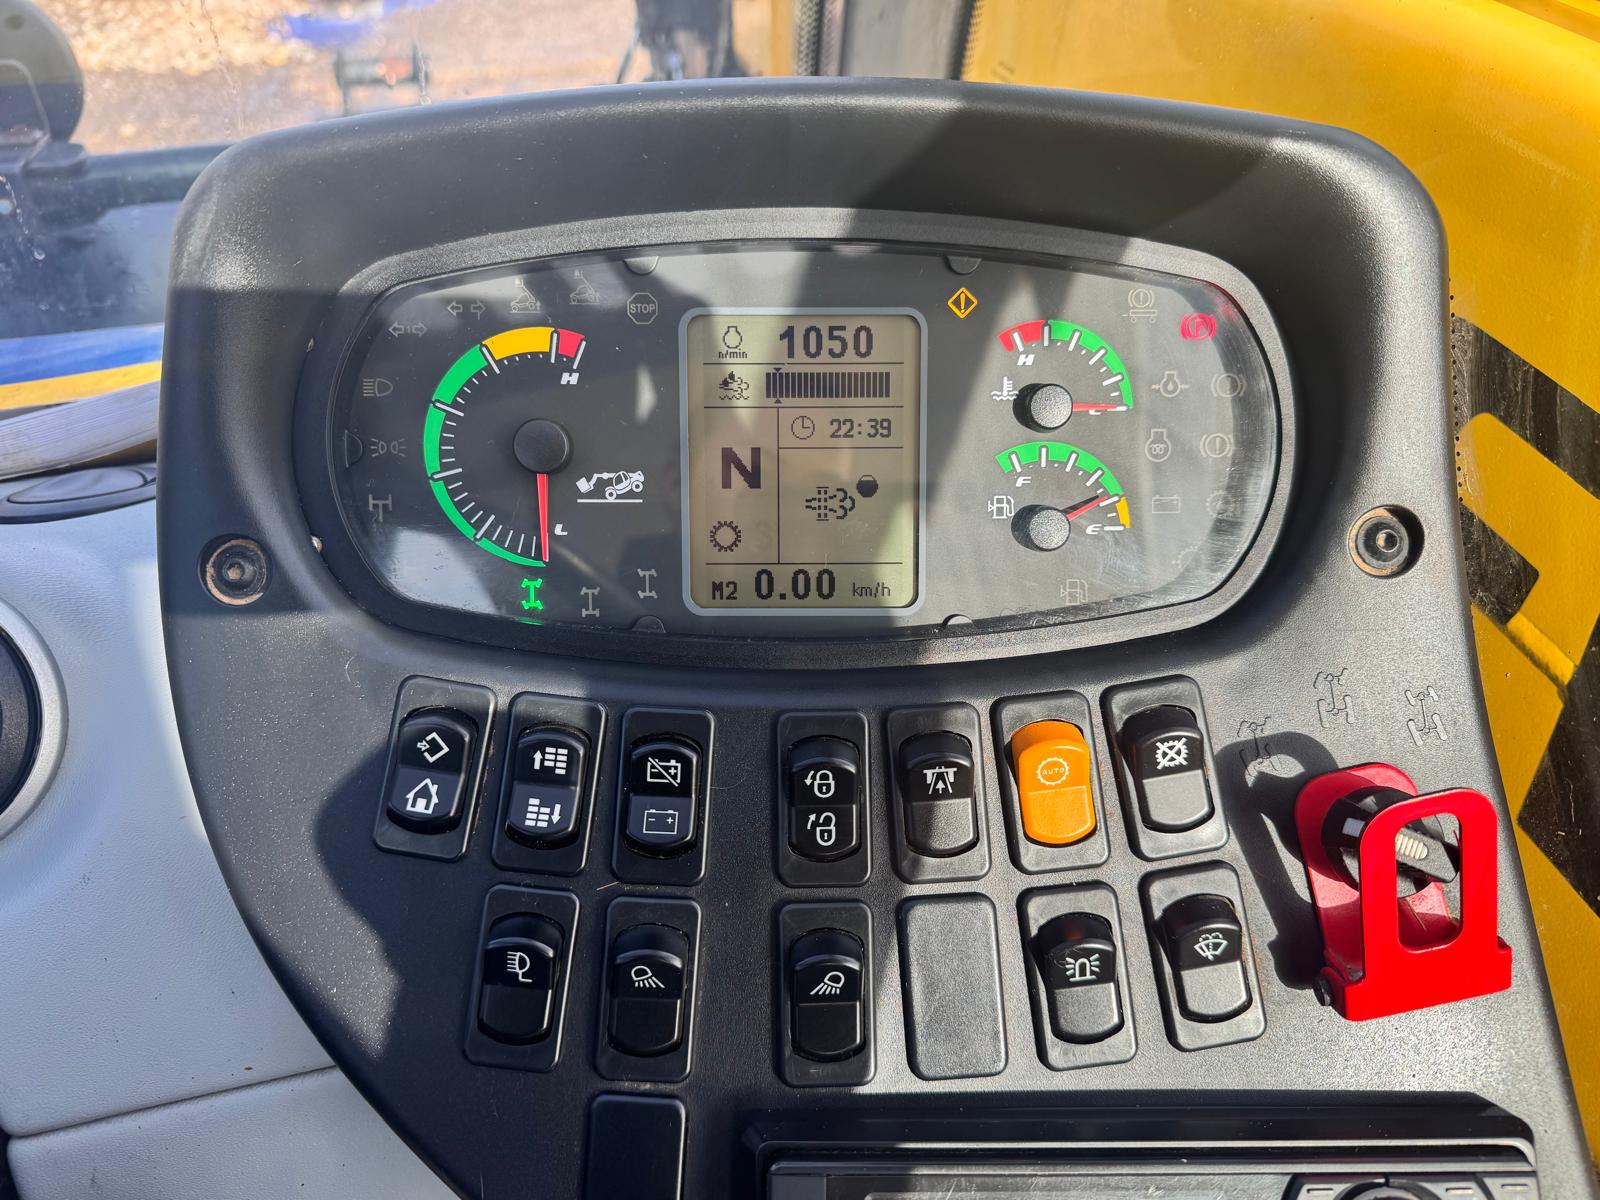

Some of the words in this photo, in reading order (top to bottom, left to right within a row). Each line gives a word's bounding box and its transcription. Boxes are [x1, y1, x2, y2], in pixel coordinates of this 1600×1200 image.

[630, 303, 655, 314] STOP
[779, 325, 873, 359] 1050
[718, 348, 748, 359] n/min
[1017, 354, 1035, 366] H
[560, 372, 580, 385] H
[829, 418, 892, 439] 22:39
[721, 447, 761, 489] N
[1015, 476, 1032, 487] F
[554, 523, 568, 536] L
[1085, 523, 1103, 535] E
[711, 581, 738, 600] M2
[755, 568, 836, 600] 0.00
[852, 582, 891, 597] km/h
[1042, 767, 1065, 775] AUTO
